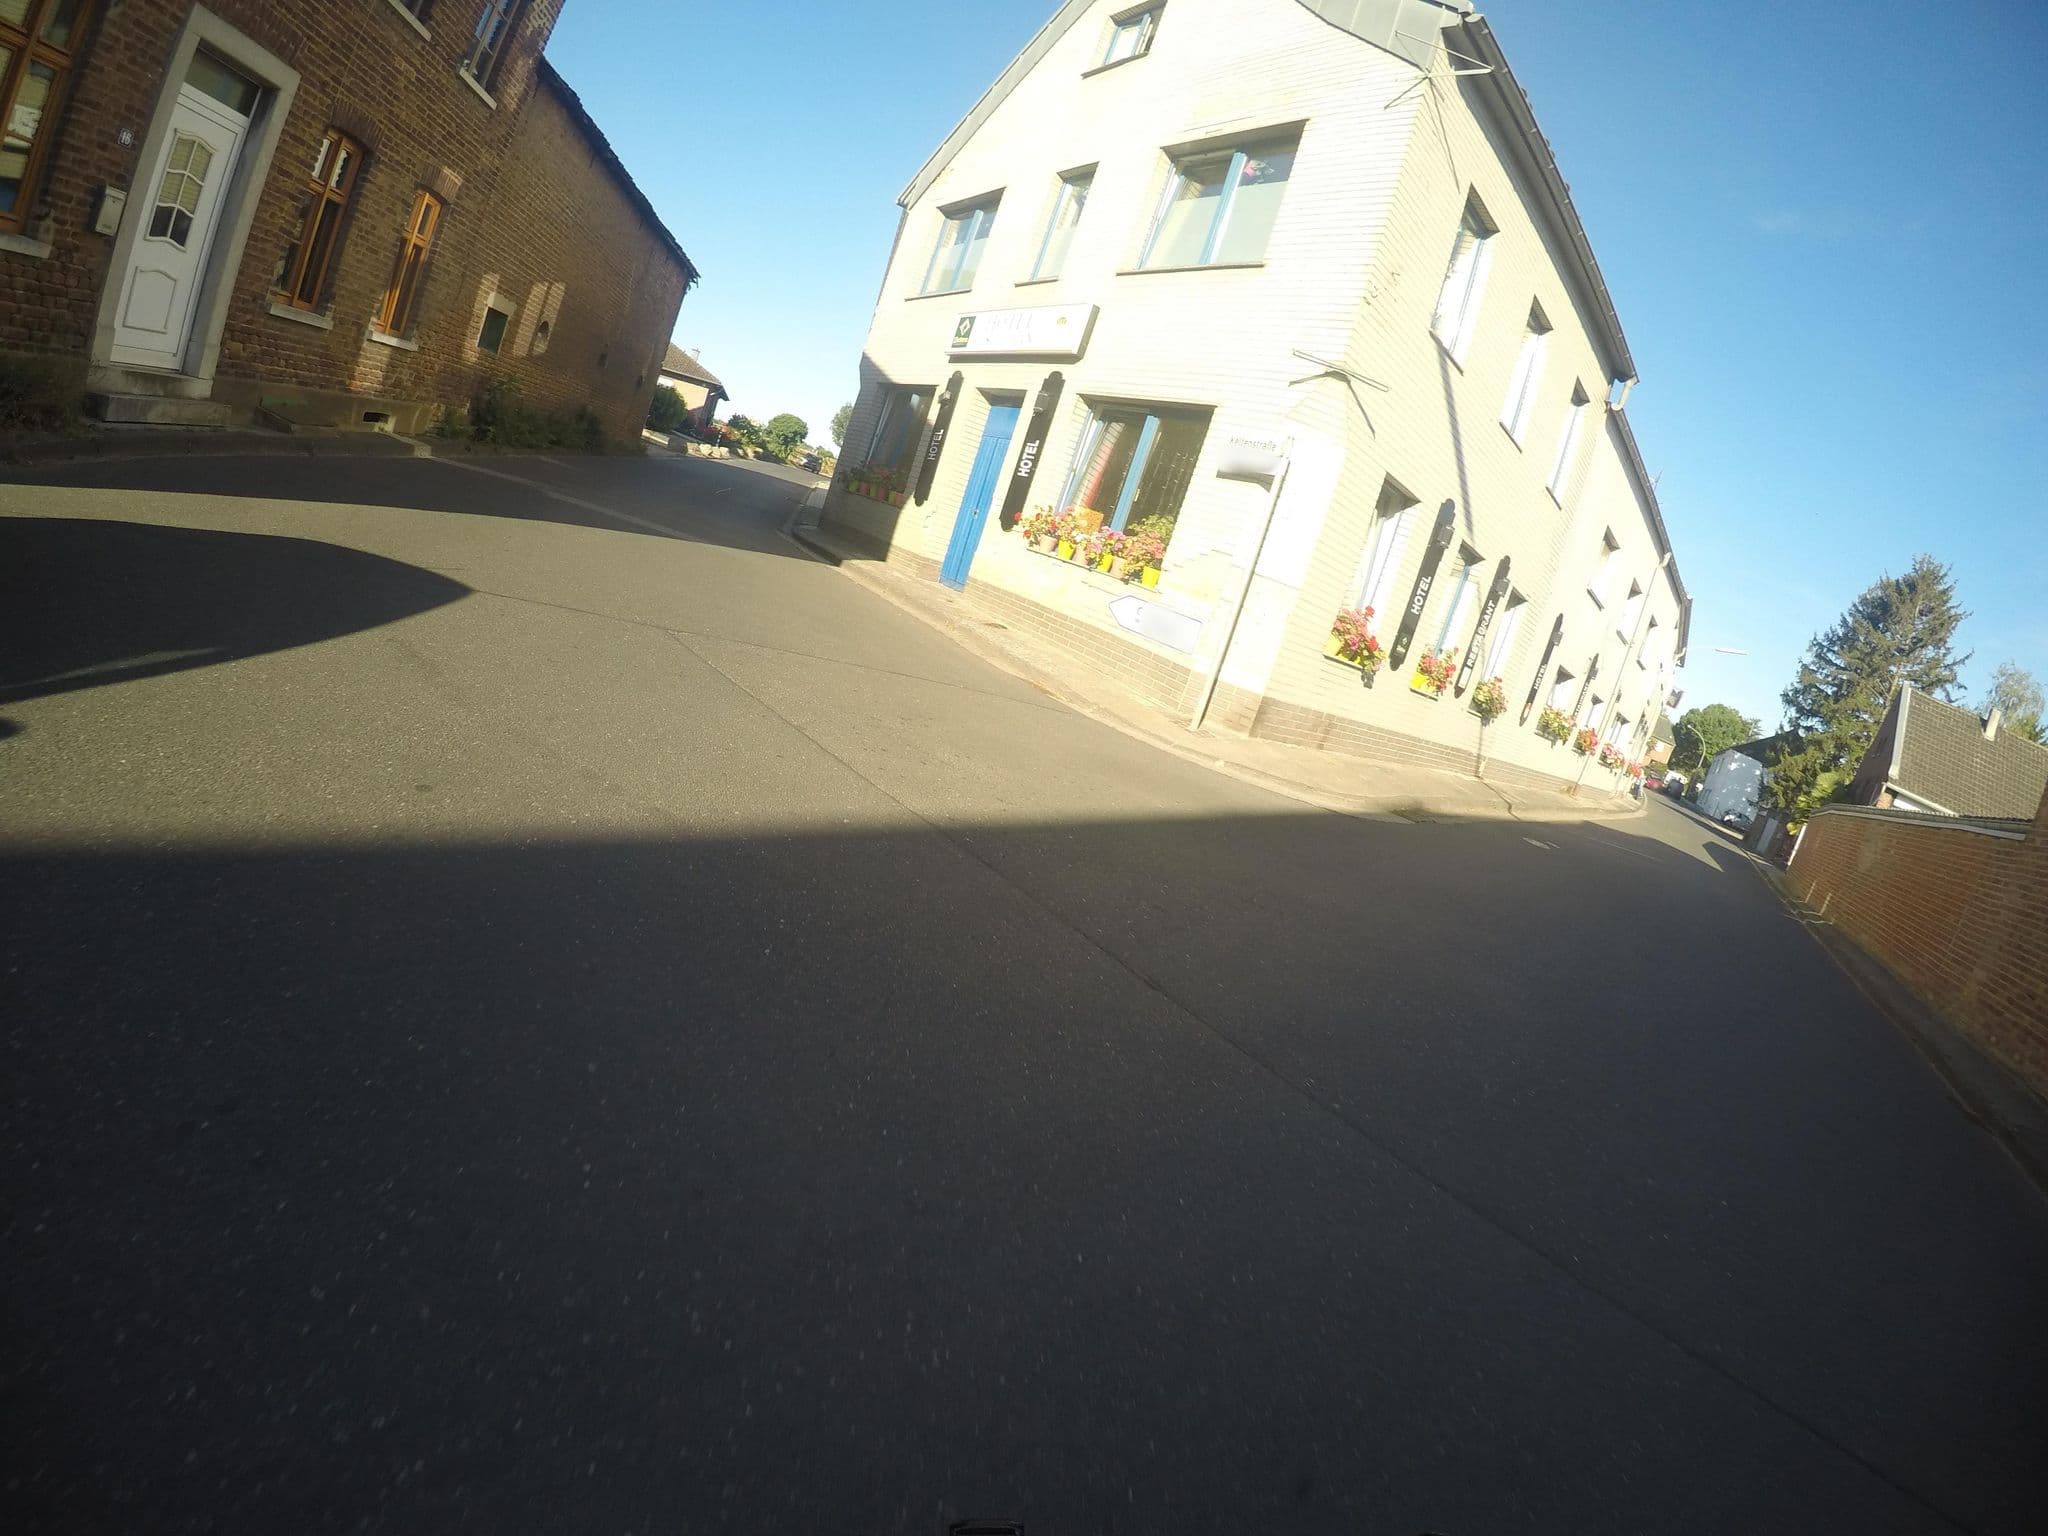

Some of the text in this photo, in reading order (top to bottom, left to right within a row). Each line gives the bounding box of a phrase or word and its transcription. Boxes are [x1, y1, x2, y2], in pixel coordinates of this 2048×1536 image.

[120, 131, 132, 145] 16
[928, 429, 944, 460] HOTEL
[1017, 439, 1040, 477] HOTEL
[1410, 575, 1432, 615] HOTEL
[1534, 663, 1547, 690] HOTEL
